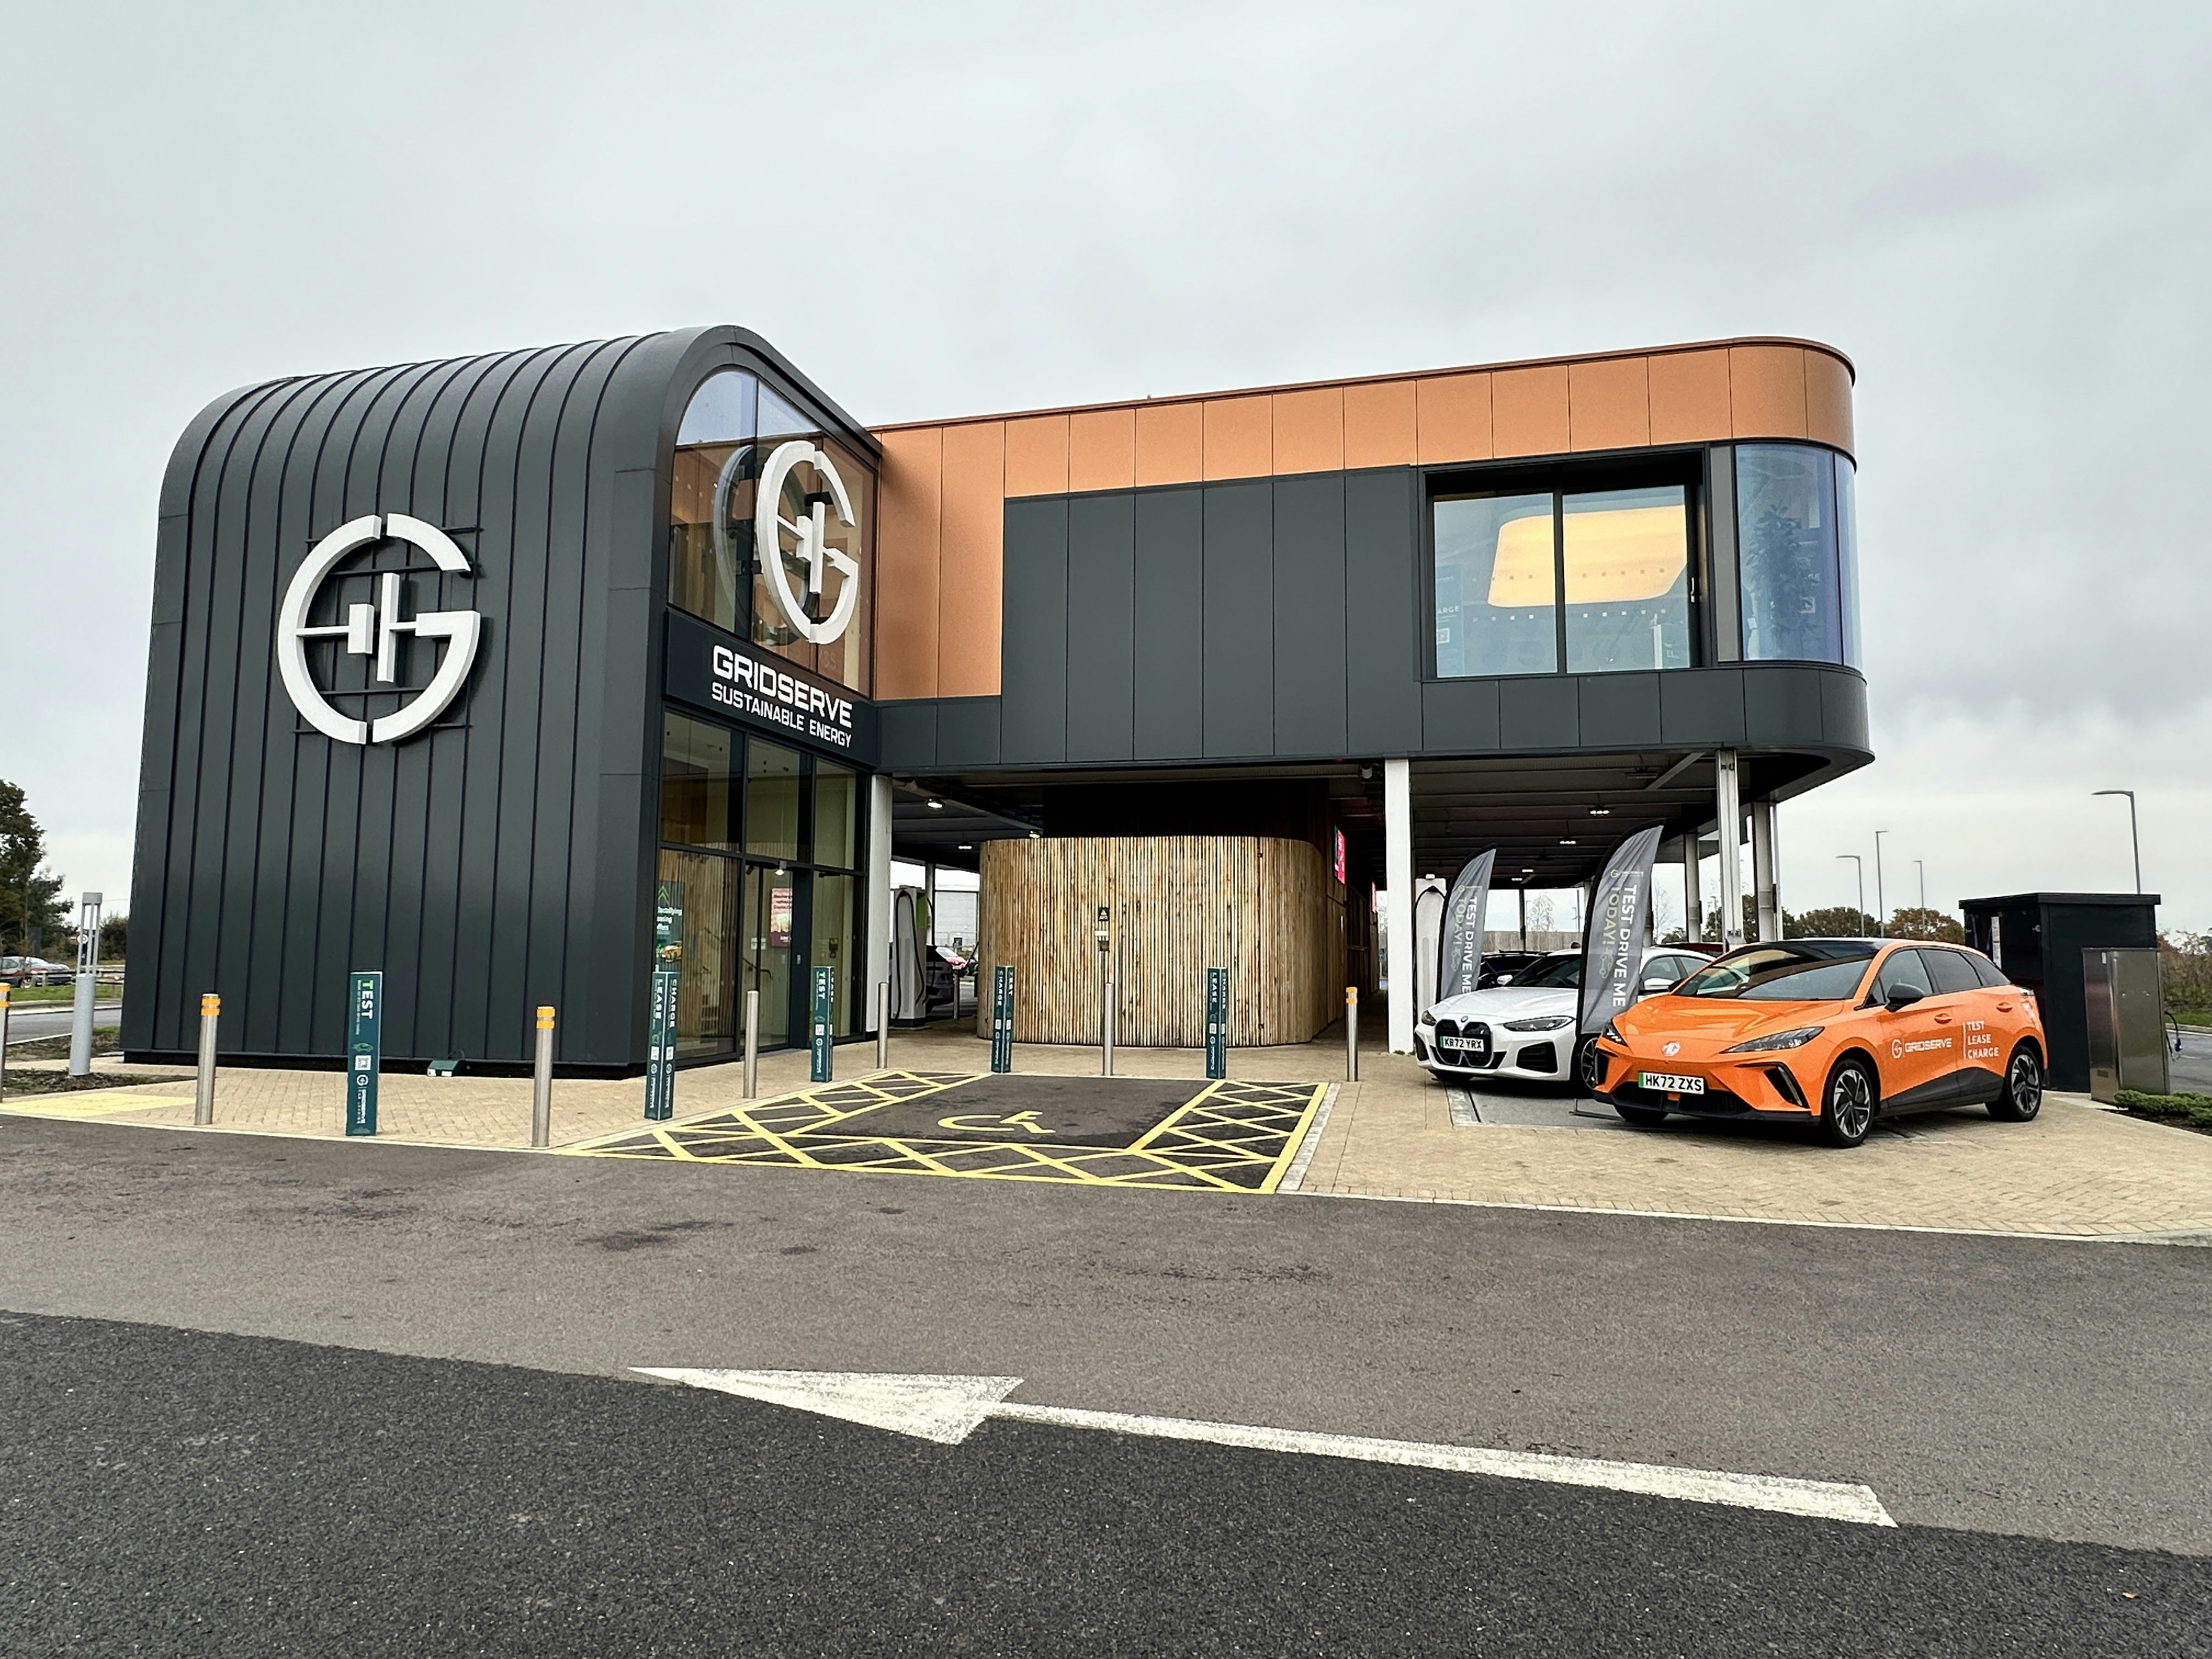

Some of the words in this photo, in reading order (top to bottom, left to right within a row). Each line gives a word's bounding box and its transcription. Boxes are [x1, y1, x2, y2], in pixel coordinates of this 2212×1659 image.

[1437, 606, 1460, 614] ARGE
[713, 645, 853, 729] GRIDSERVE
[712, 682, 804, 731] SUSTAINABLE
[809, 719, 851, 748] ENERGY
[1466, 896, 1477, 928] TEST
[1602, 887, 1621, 945] TODAY!
[1621, 884, 1637, 924] TEST
[1453, 896, 1467, 945] TODAY!
[1462, 931, 1474, 971] DRIVE
[1614, 928, 1630, 978] DRIVE
[1462, 974, 1472, 994] ME
[1613, 983, 1626, 1007] ME
[362, 980, 374, 1019] TEST
[1967, 1020, 1984, 1031] TEST
[1466, 1039, 1481, 1049] YRX
[1905, 1037, 1952, 1053] GRIDSERVE
[1967, 1034, 1991, 1046] LEASE
[1967, 1047, 1999, 1059] CHARGE
[1646, 1074, 1675, 1088] HK72
[1678, 1077, 1702, 1091] ZXS
